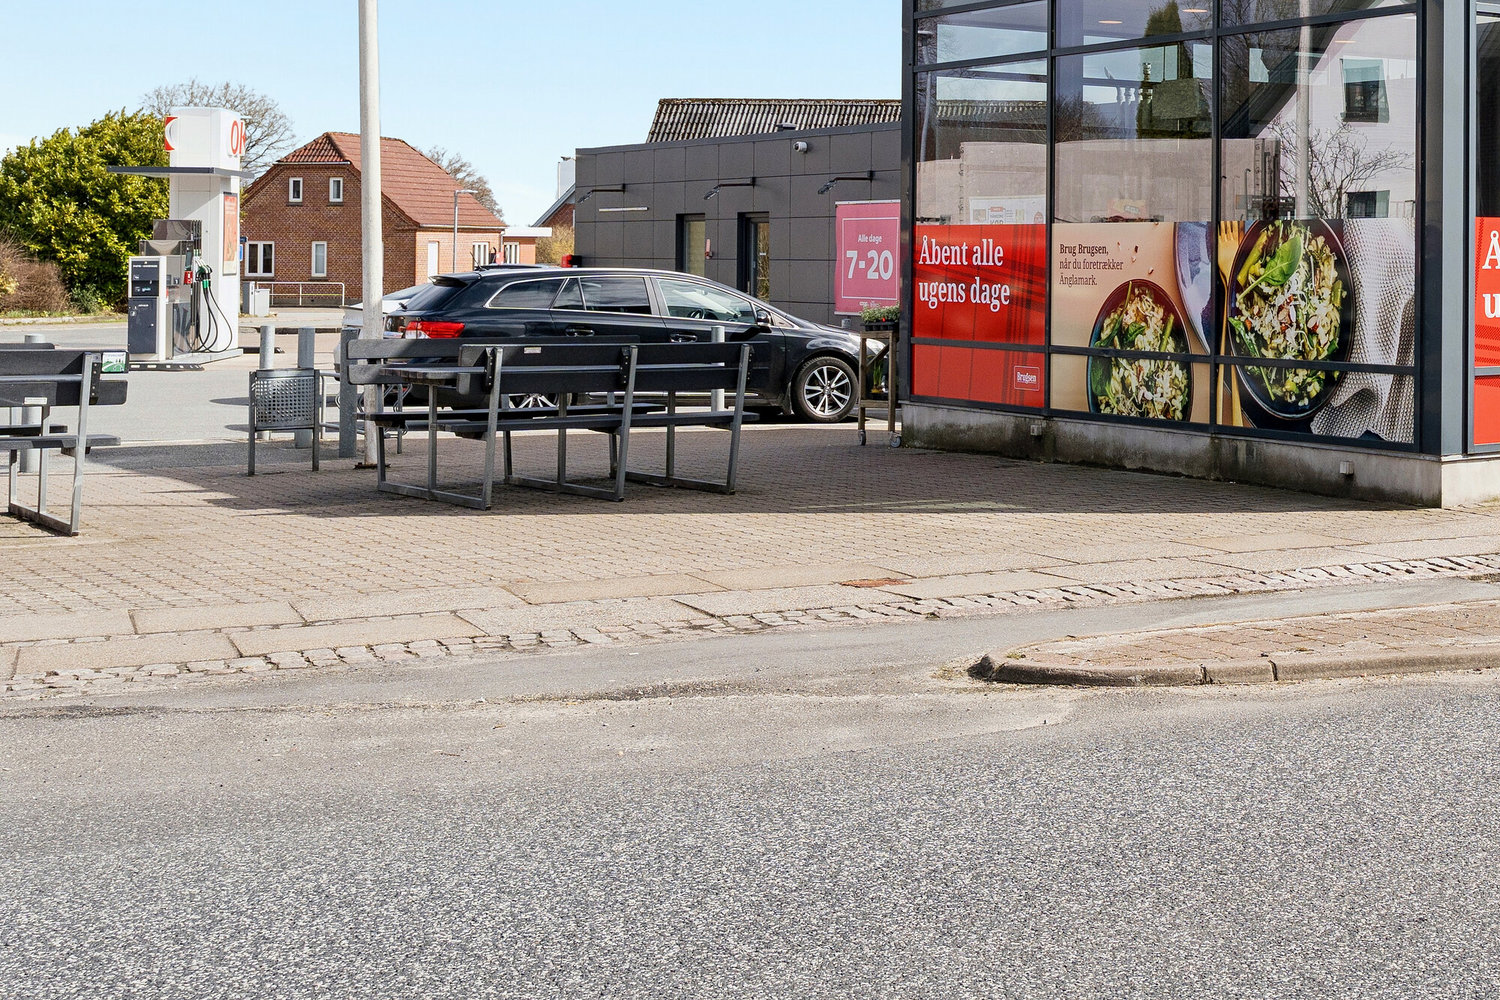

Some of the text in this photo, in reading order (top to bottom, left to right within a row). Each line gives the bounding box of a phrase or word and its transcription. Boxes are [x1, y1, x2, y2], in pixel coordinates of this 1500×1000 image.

[858, 234, 882, 244] Alle dage
[1060, 243, 1109, 257] Brug Brugsen,
[918, 235, 1004, 266] Åbent alle
[846, 250, 893, 280] 7-20
[1060, 258, 1124, 271] når du foretrækker
[918, 276, 1010, 312] ugens dage
